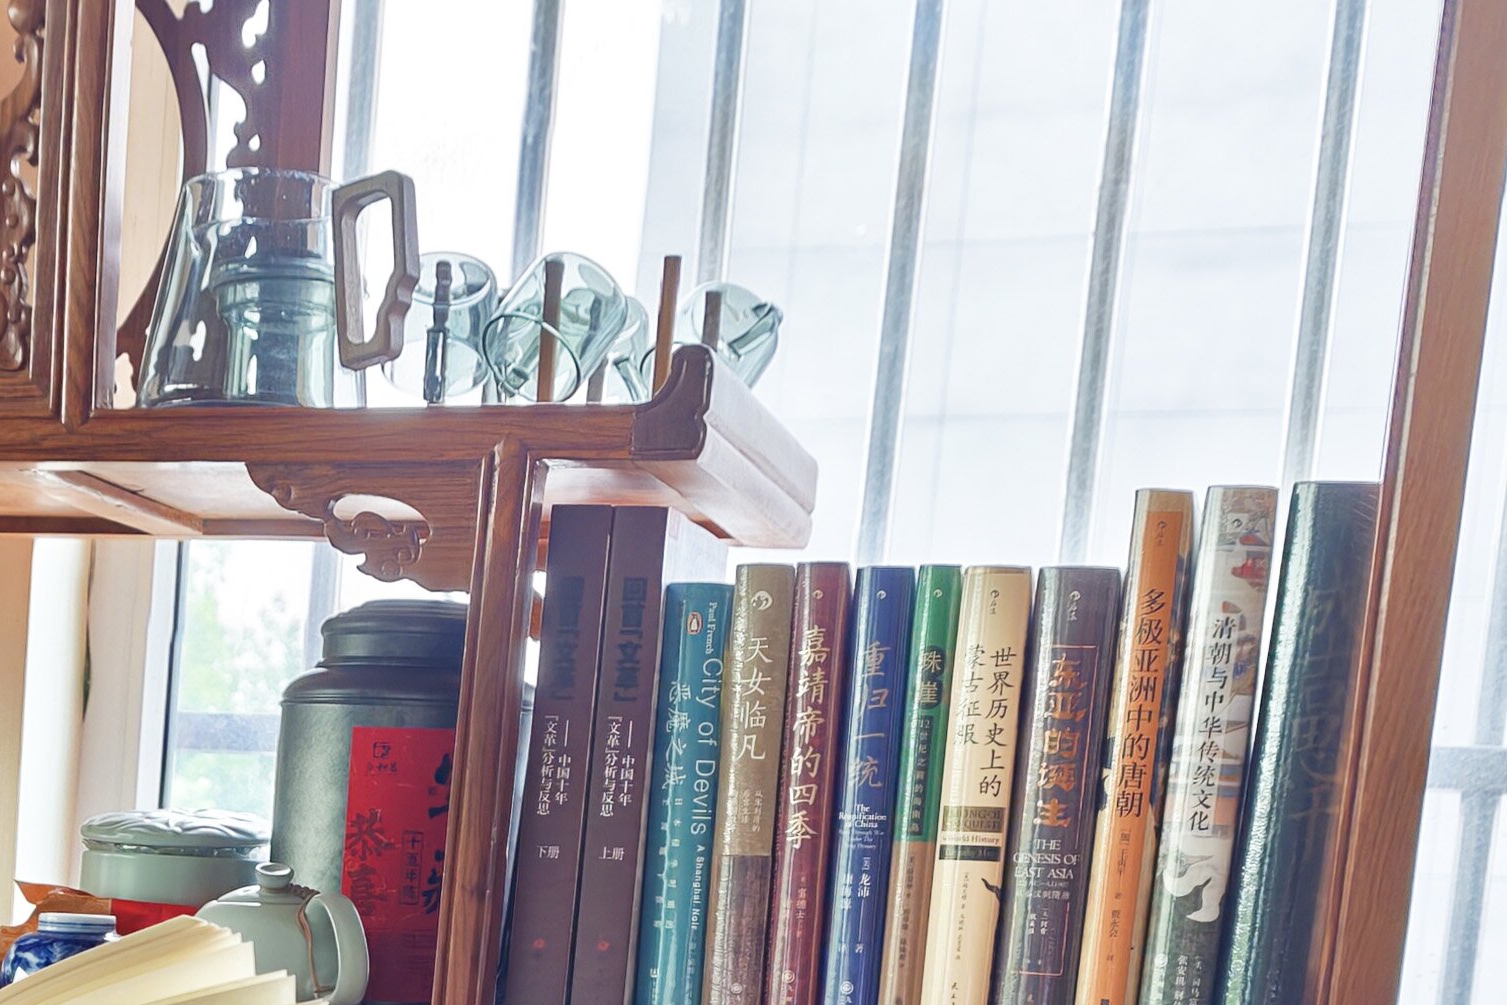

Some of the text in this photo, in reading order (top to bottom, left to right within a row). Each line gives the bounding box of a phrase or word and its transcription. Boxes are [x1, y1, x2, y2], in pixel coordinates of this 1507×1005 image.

[708, 602, 718, 623] Paul
[705, 624, 717, 654] French
[695, 658, 723, 709] City
[918, 650, 942, 705] 珠崖
[737, 637, 773, 760] 天女临凡
[1116, 588, 1165, 818] 多极亚洲中的唐朝
[850, 640, 891, 788] 重归一统
[979, 647, 1017, 797] 世界历史上的
[1188, 615, 1236, 833] 清朝与中华传统文化
[697, 721, 717, 747] of
[785, 624, 830, 849] 嘉靖帝的四季
[690, 759, 715, 835] Devils
[856, 803, 871, 812] The
[854, 819, 878, 828] China
[536, 845, 560, 859] 下册
[598, 845, 625, 861] 上册
[696, 844, 705, 853] A
[1013, 852, 1061, 865] GENESIS
[1063, 853, 1080, 866] OF
[1035, 838, 1062, 851] THE
[692, 856, 704, 905] Shanghai
[1014, 866, 1074, 880] EAST ASIA
